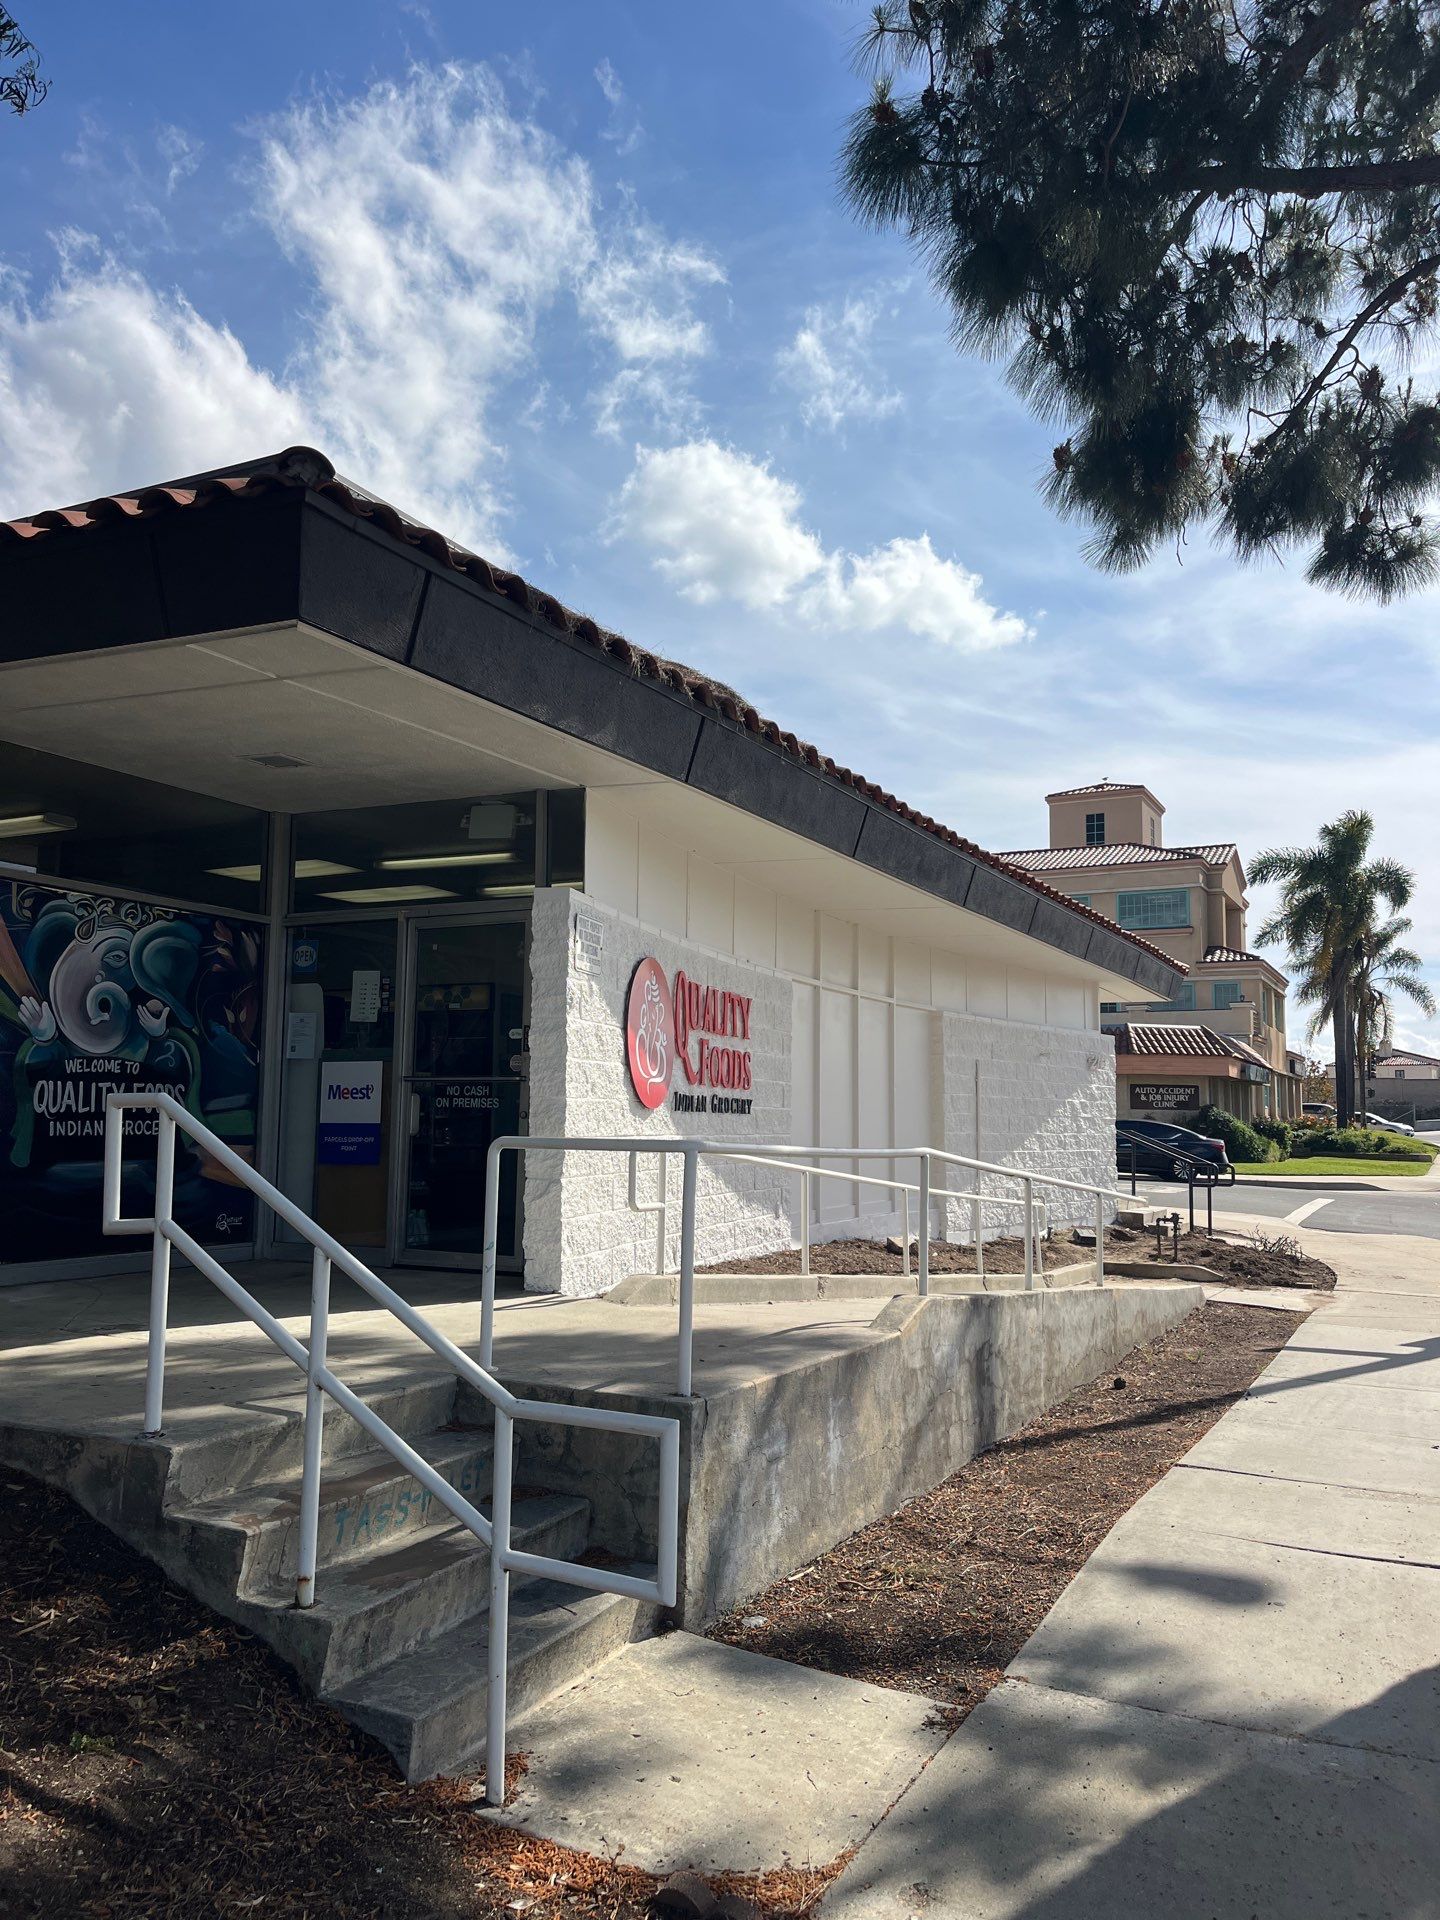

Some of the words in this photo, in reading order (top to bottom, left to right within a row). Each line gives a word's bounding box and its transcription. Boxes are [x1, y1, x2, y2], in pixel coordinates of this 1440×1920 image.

[294, 950, 314, 962] OPEN
[674, 970, 753, 1086] QUALITY
[65, 1058, 121, 1074] WELCOME
[125, 1060, 140, 1075] TO
[699, 1037, 752, 1091] FOODS
[328, 1084, 374, 1100] Meest
[446, 1085, 460, 1096] NO
[463, 1085, 490, 1096] CASH
[1135, 1086, 1156, 1094] AUTO
[1159, 1087, 1195, 1095] ACCIDENT
[1140, 1093, 1147, 1101] &
[1149, 1094, 1161, 1102] JOB
[1164, 1094, 1190, 1102] INJURY
[435, 1097, 449, 1108] ON
[452, 1097, 500, 1108] PREMISES
[674, 1091, 706, 1113] INDIAN
[711, 1093, 753, 1114] GROCERY
[50, 1120, 104, 1137] INDIAN
